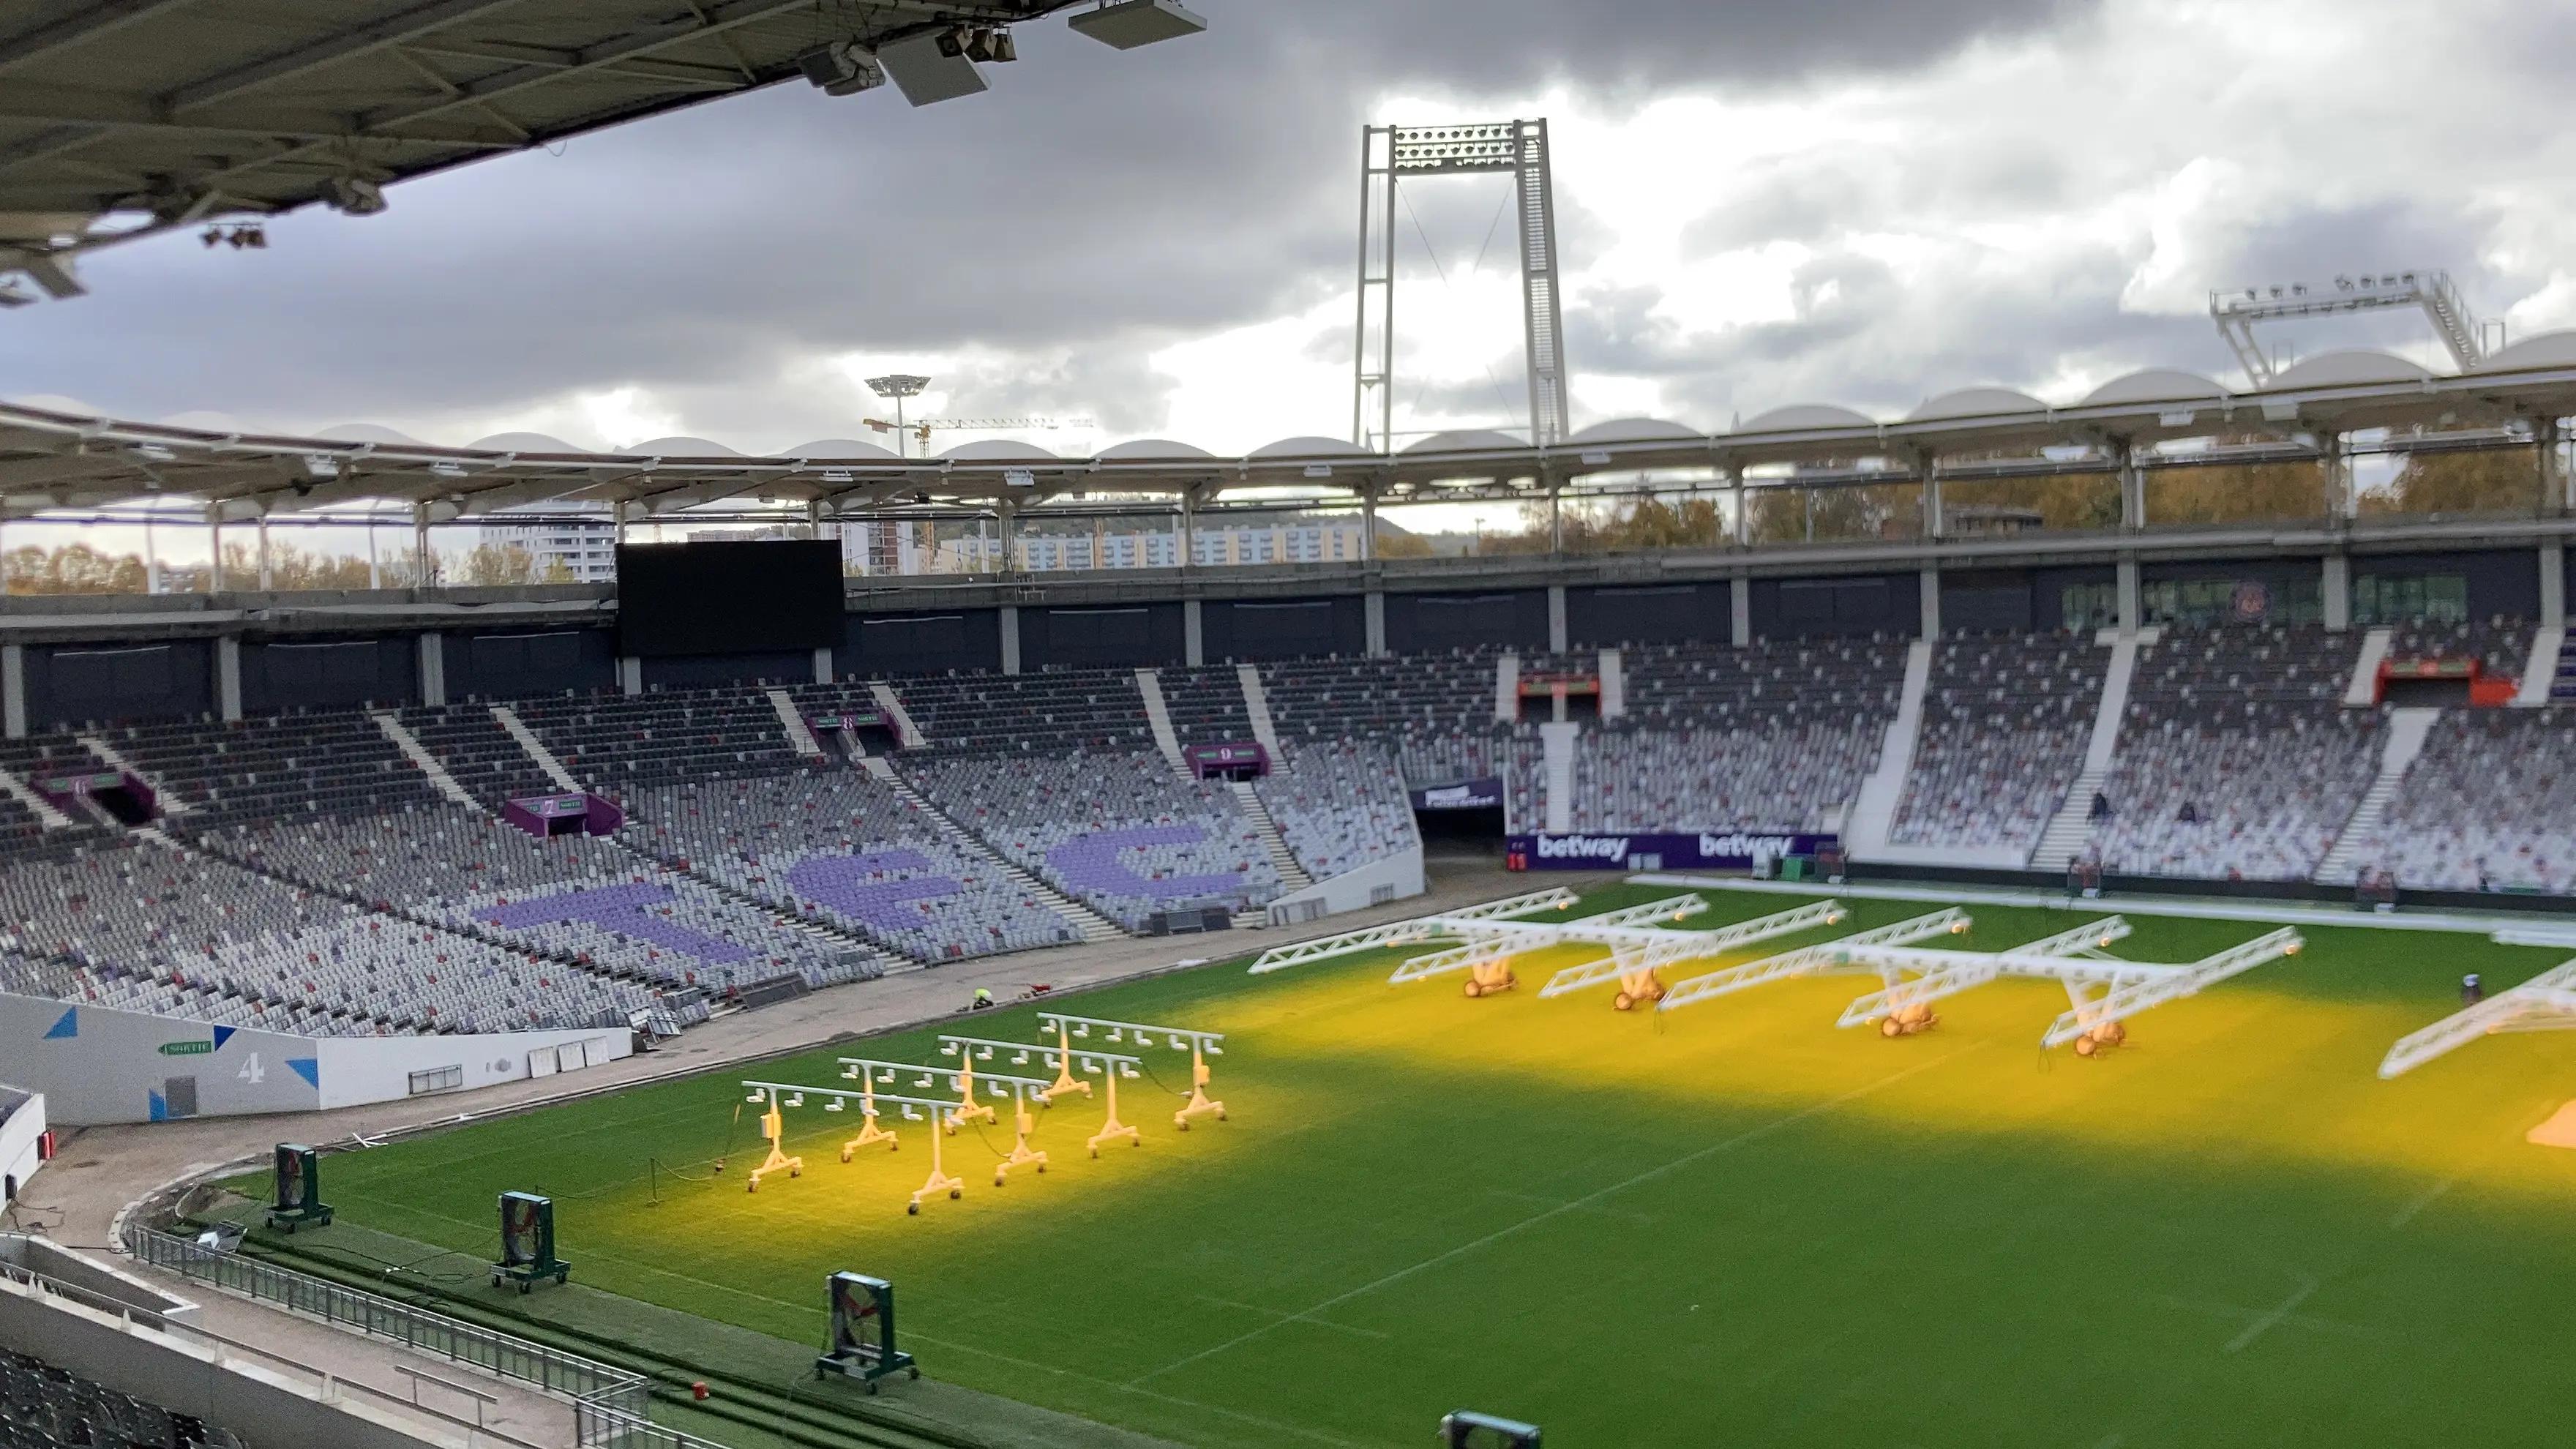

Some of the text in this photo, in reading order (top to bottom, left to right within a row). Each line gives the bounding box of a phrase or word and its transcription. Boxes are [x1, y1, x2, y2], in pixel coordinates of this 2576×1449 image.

[544, 798, 554, 815] 7
[1538, 832, 1628, 862] betway
[236, 1052, 264, 1084] 4
